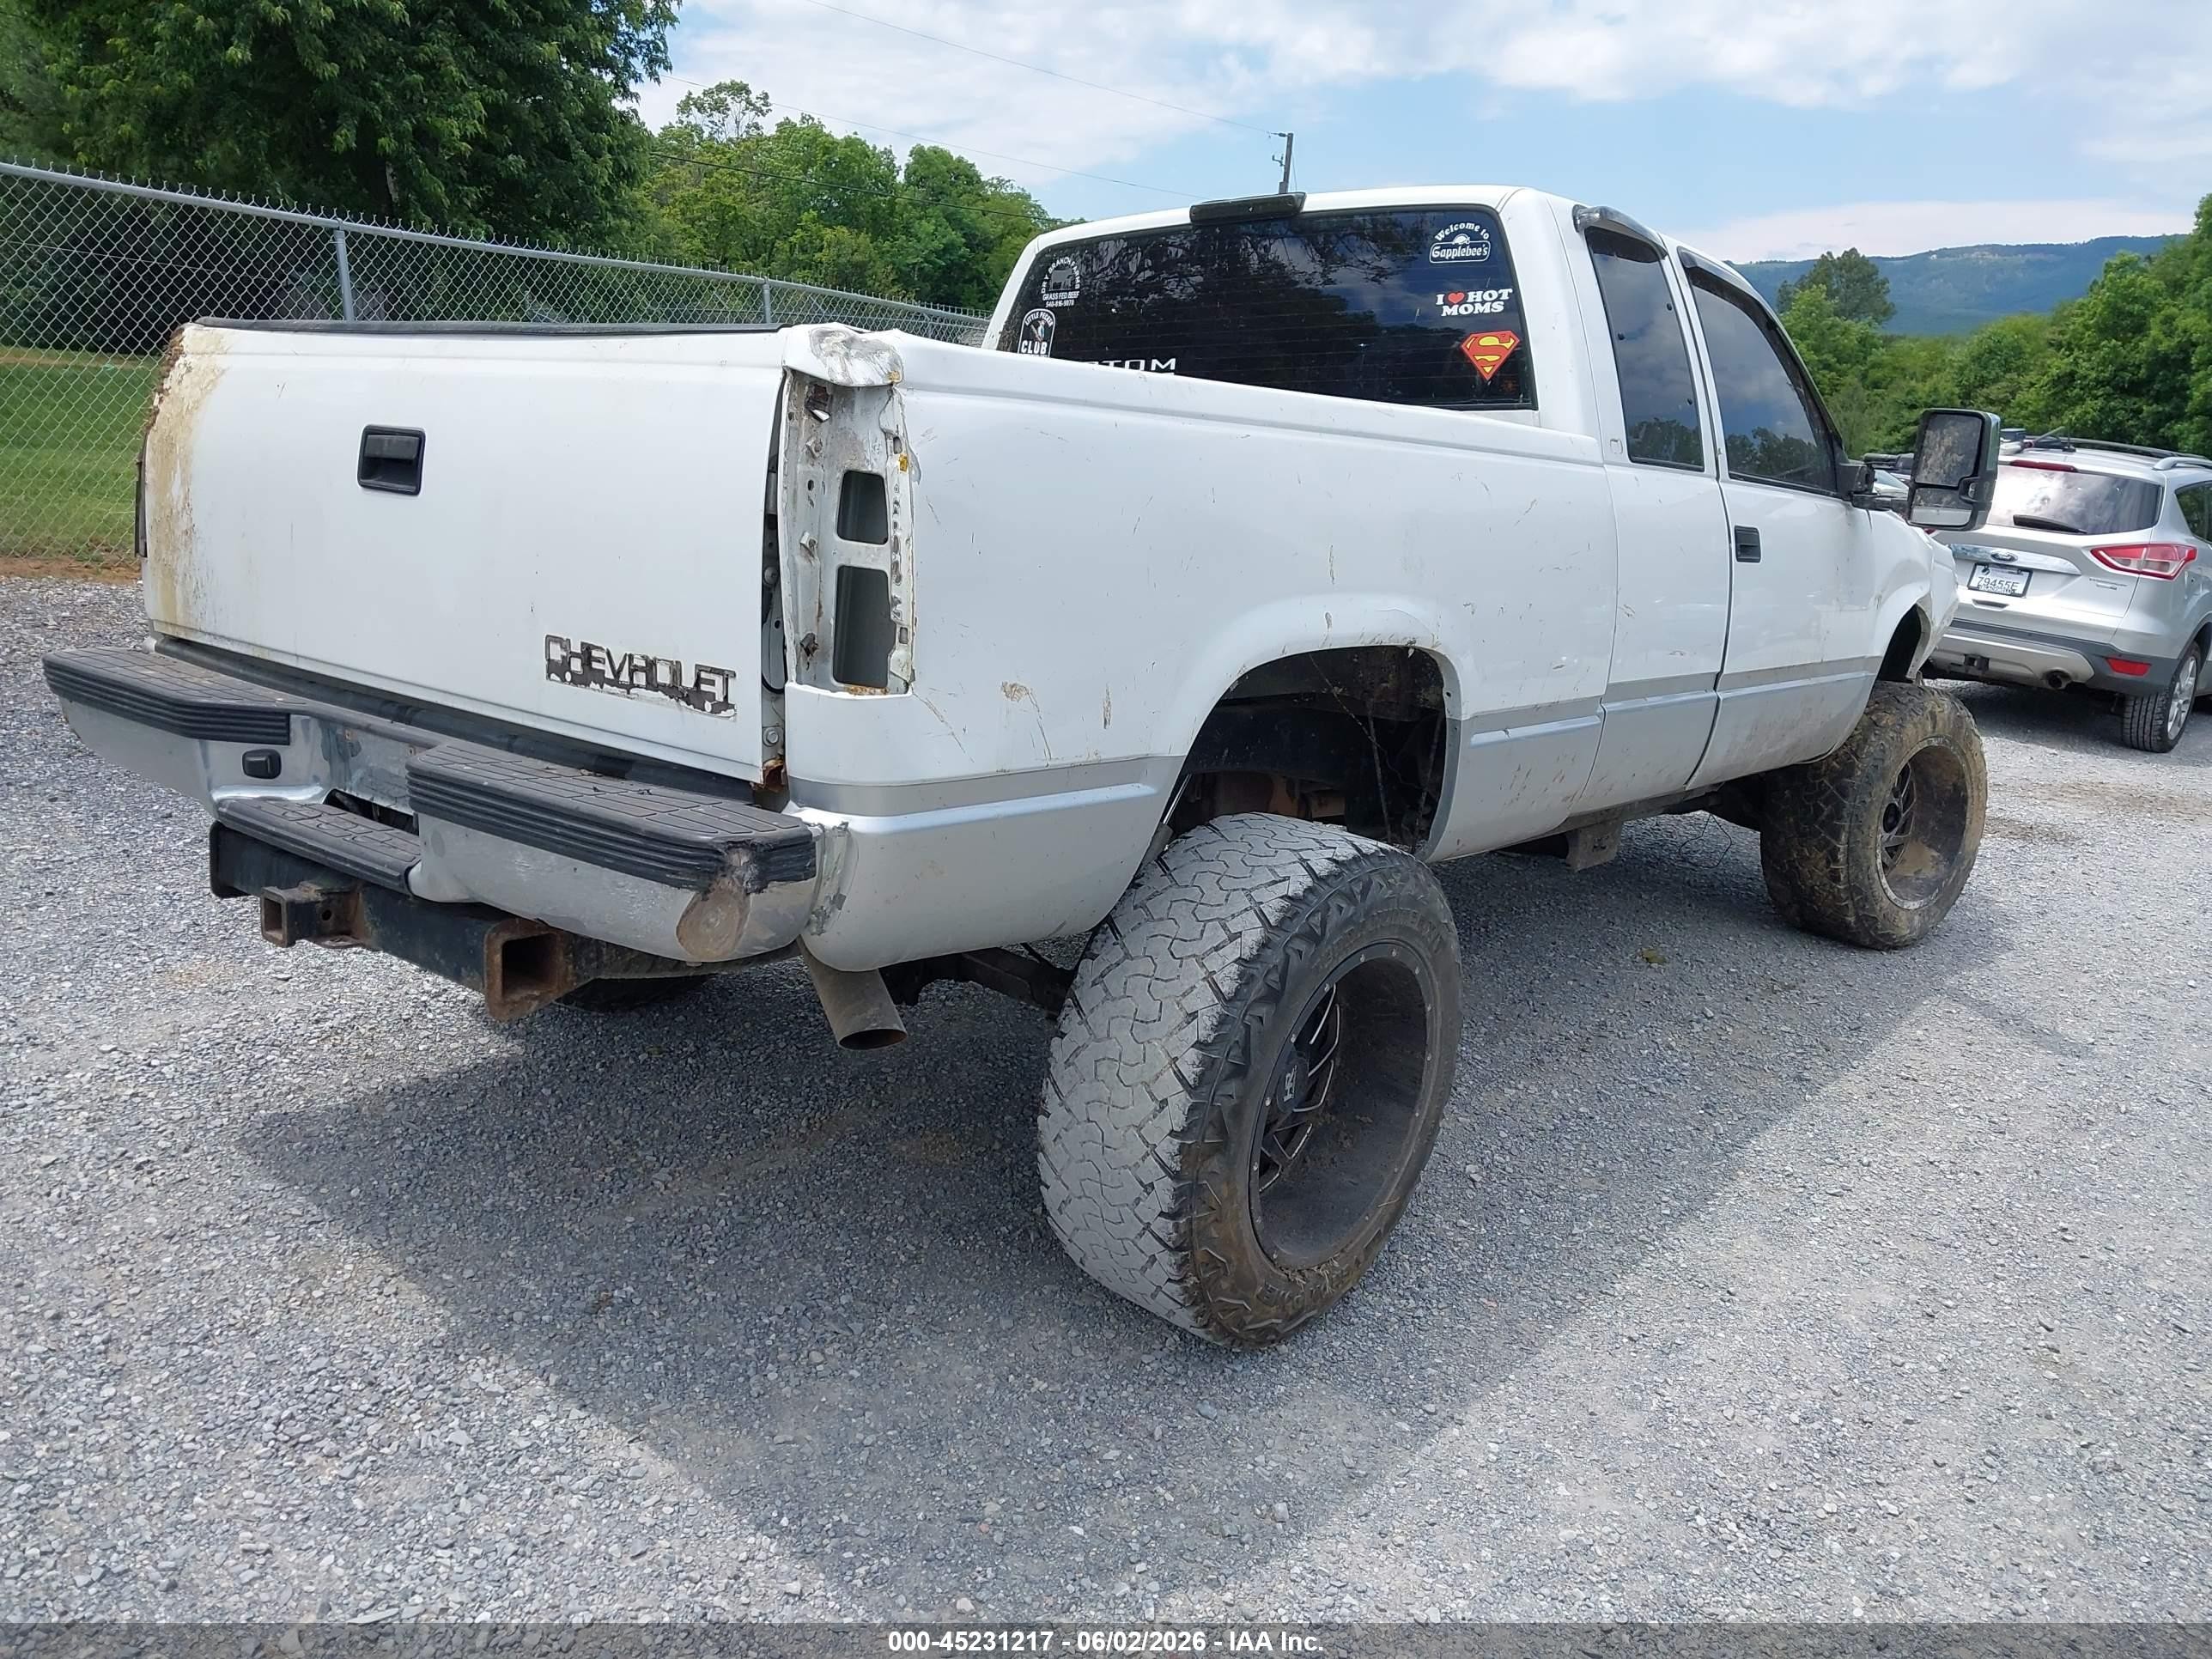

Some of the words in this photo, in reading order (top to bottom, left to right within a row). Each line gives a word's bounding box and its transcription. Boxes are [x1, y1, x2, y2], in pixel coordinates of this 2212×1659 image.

[1435, 222, 1480, 241] Welcome
[1480, 228, 1490, 240] to
[1431, 244, 1488, 259] Gapplebee's
[1436, 294, 1445, 305] I
[1467, 289, 1513, 303] HOT
[1441, 301, 1504, 317] MOMS
[1021, 340, 1048, 354] CLUB
